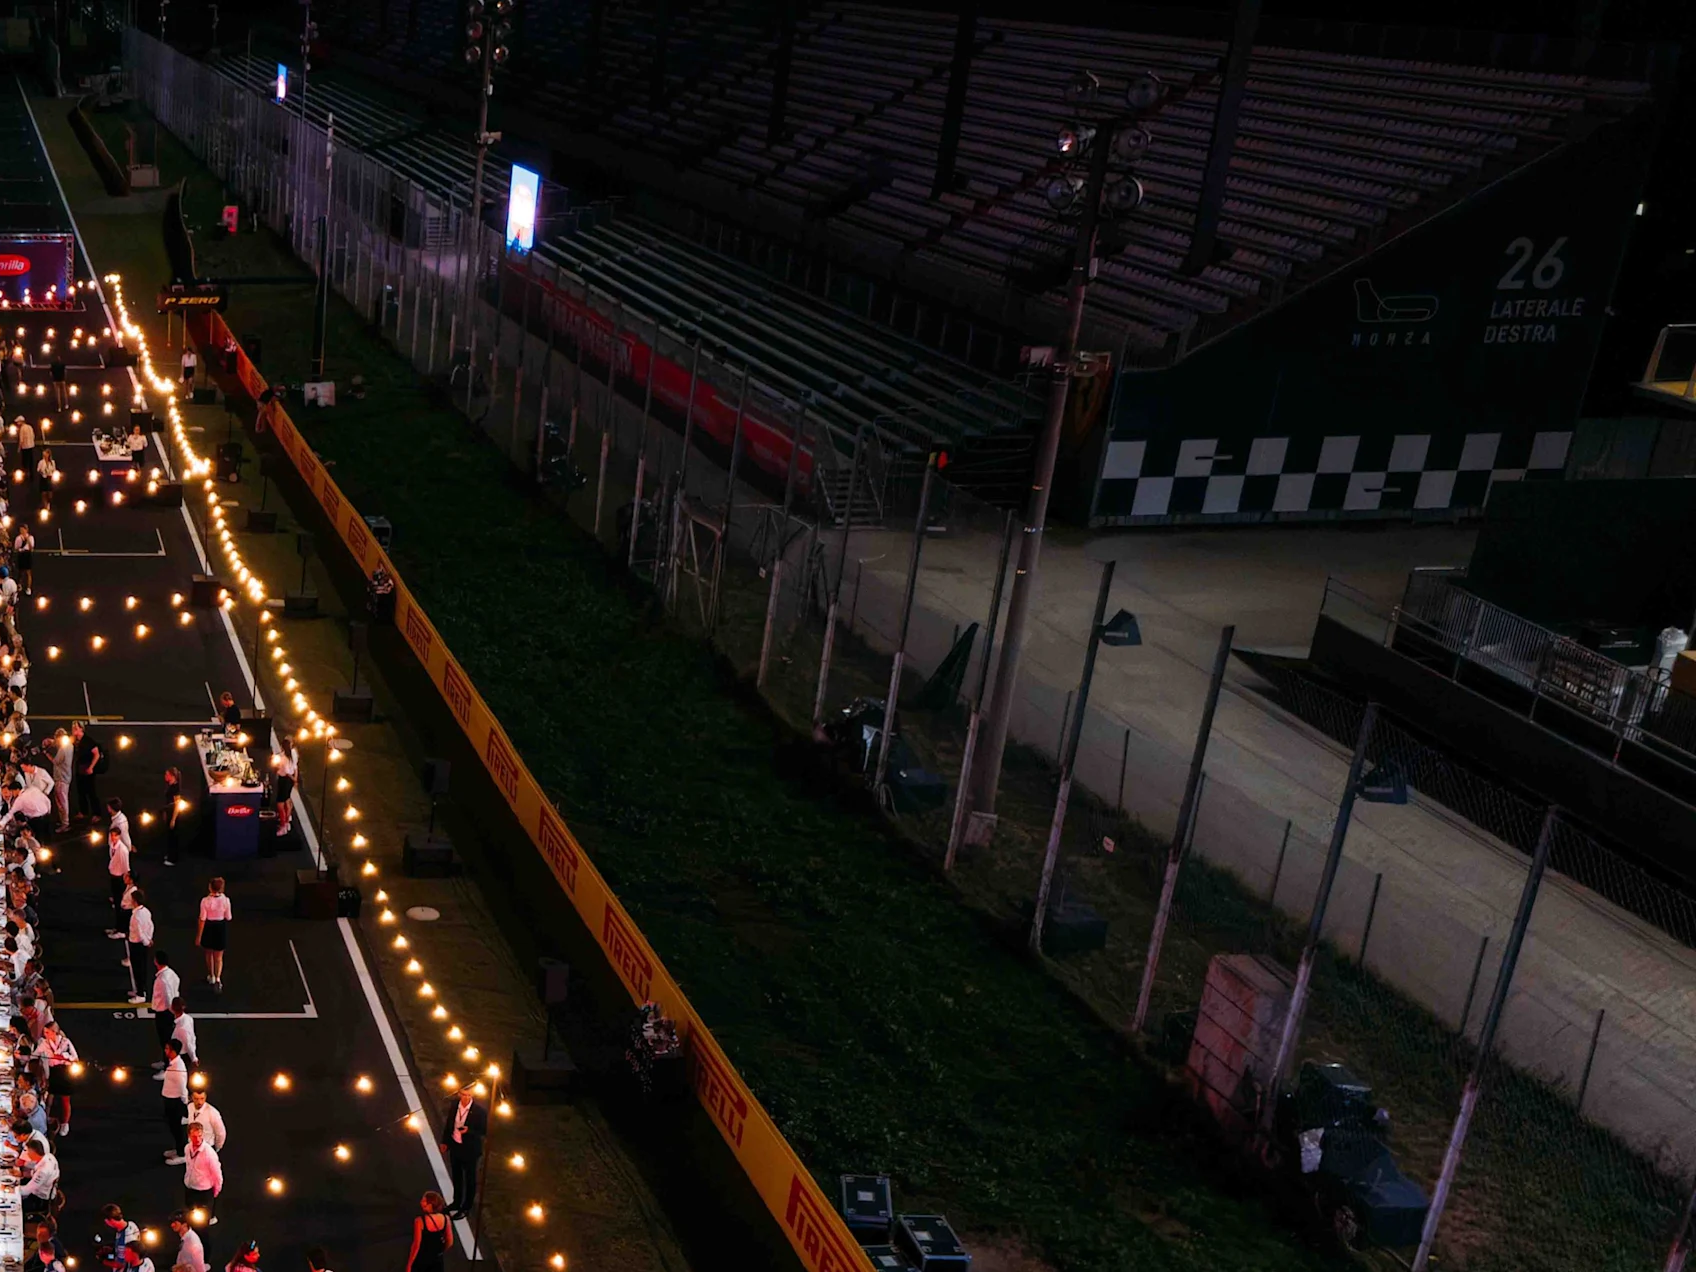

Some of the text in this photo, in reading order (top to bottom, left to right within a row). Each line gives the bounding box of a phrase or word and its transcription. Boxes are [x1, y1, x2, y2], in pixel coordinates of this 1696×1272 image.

[1497, 236, 1569, 291] 26
[1483, 323, 1557, 344] DESTRA
[1489, 297, 1586, 319] LATERALE
[444, 658, 472, 729] PIRELLI
[487, 726, 519, 804] PIRELLI
[538, 804, 579, 896] PIRELLI
[603, 901, 653, 1004] PIRELLI
